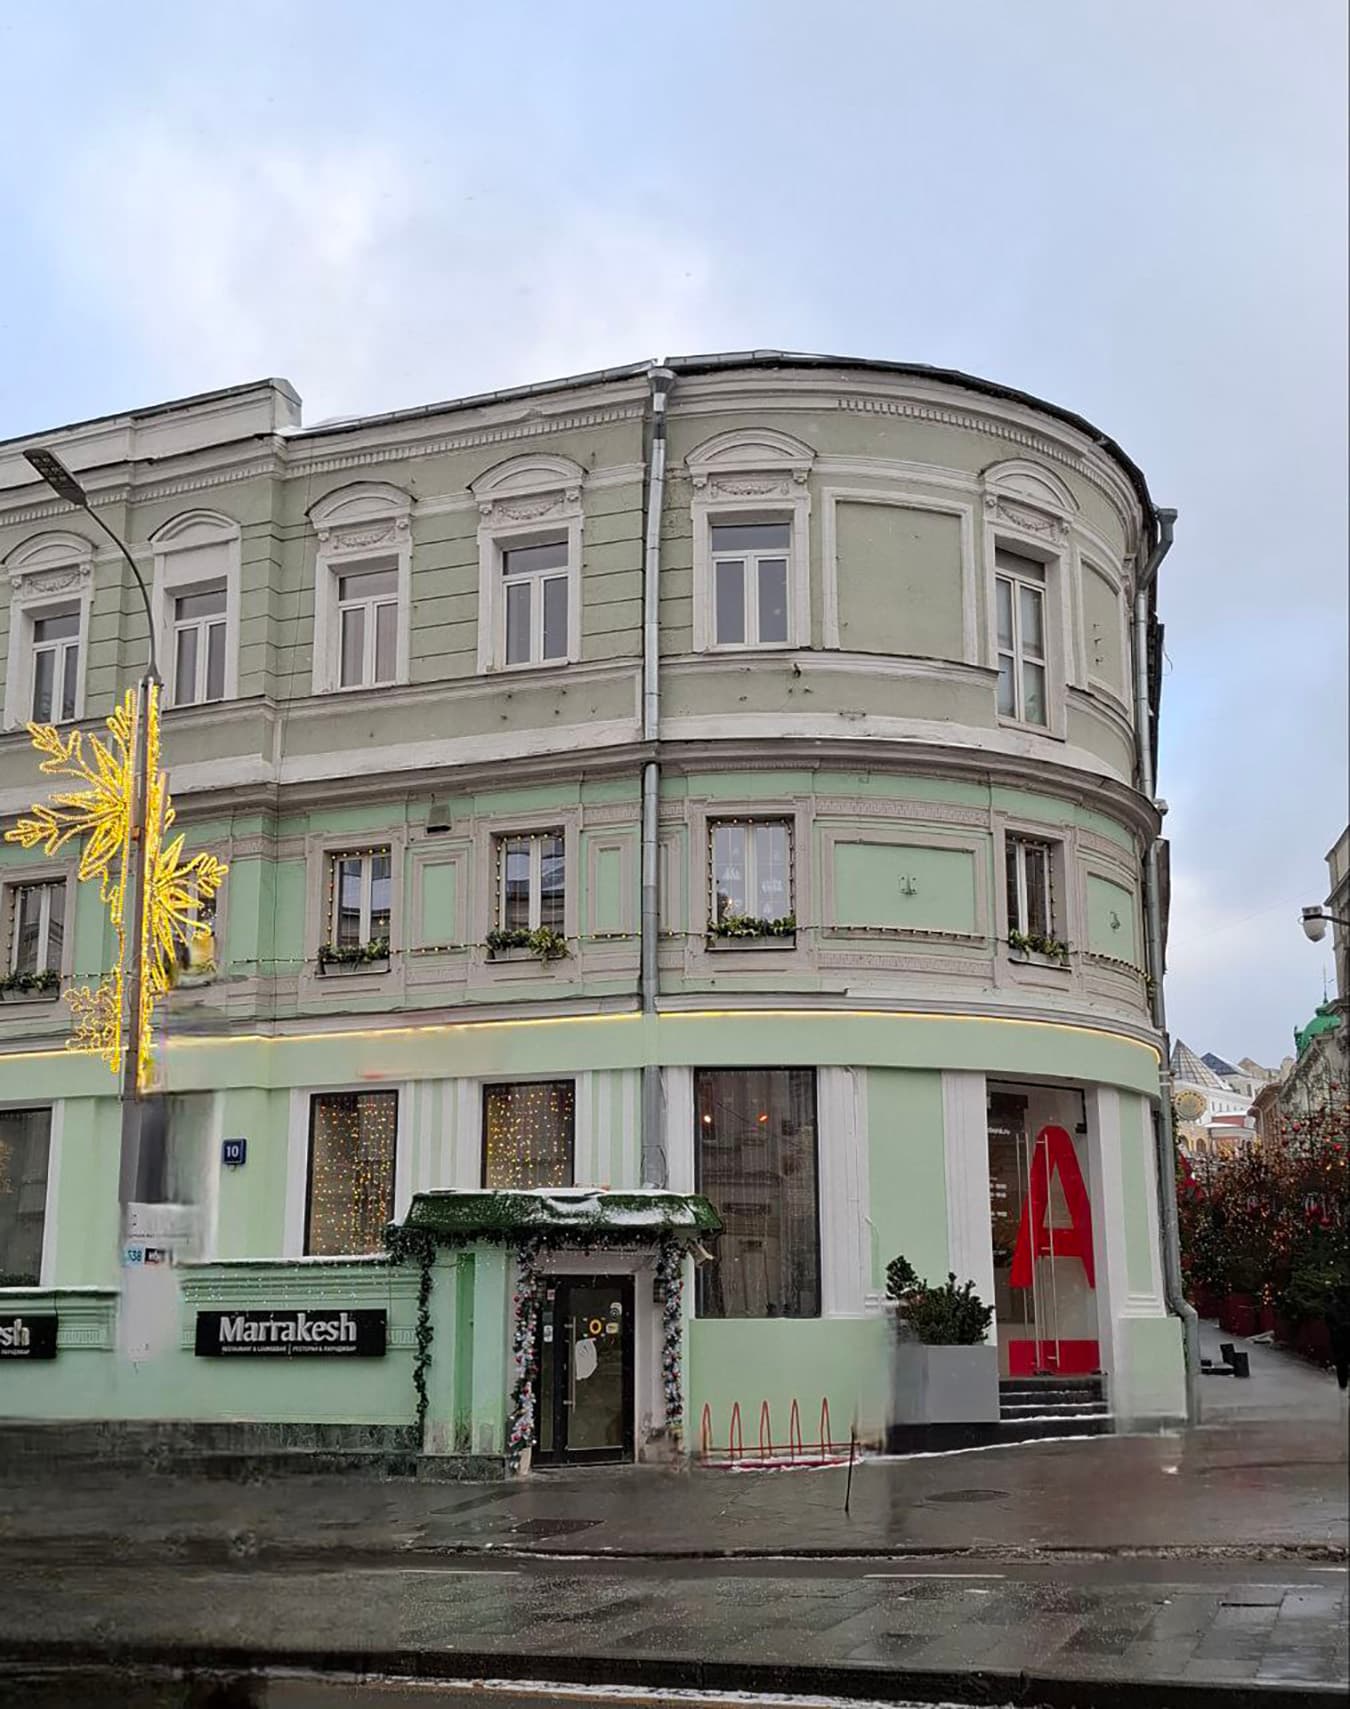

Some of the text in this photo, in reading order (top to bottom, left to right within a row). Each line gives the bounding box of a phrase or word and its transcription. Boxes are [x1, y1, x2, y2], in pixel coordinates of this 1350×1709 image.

[226, 1145, 239, 1158] 10
[1009, 1125, 1095, 1289] A
[0, 1318, 30, 1347] sh
[219, 1312, 358, 1342] Marrakesh
